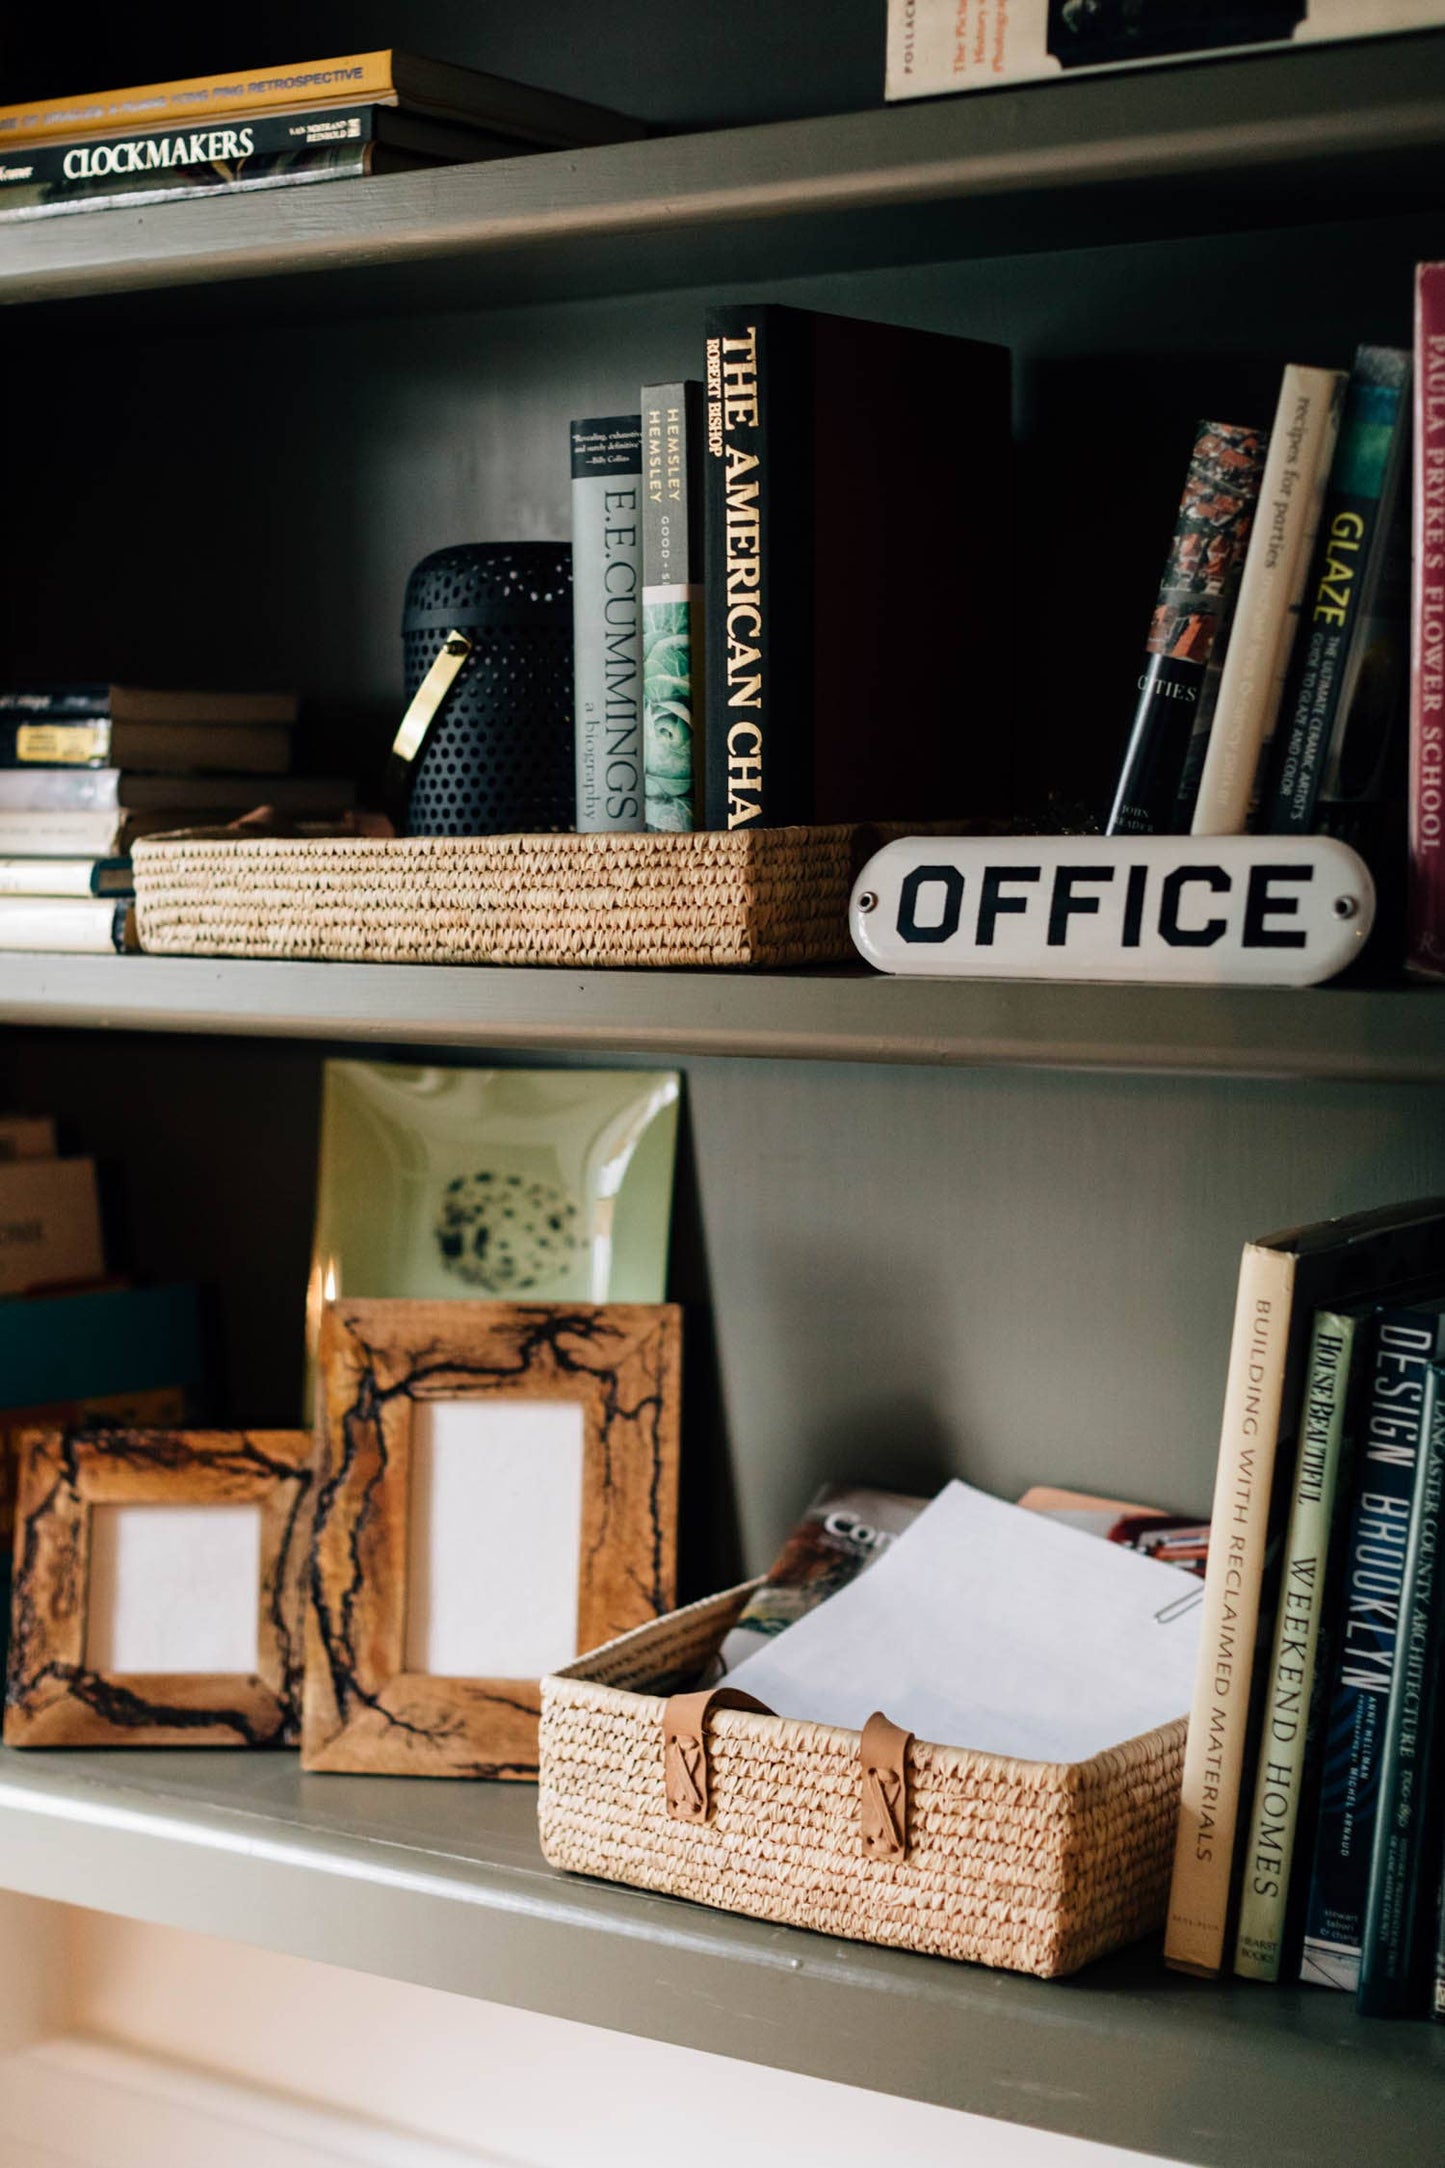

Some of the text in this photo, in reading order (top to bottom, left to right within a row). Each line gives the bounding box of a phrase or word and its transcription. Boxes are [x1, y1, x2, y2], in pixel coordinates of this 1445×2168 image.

[247, 66, 364, 94] RETROSPECTIVE
[62, 127, 255, 180] CLOCKMAKERS
[706, 338, 724, 457] ROBERT BISHOP
[1427, 335, 1445, 433] PAULA
[649, 410, 662, 503] HEMSLEY
[667, 408, 681, 501] HEMSLEY
[1264, 397, 1310, 570] recipes for parties
[661, 516, 670, 558] GOOD
[722, 326, 763, 831] THE AMERICAN CHA
[1313, 511, 1365, 627] GLAZE
[1136, 674, 1198, 703] CTIES
[1312, 659, 1334, 715] ULTIMATE
[1422, 585, 1445, 713] FLOWER
[582, 702, 601, 820] a biography
[1280, 757, 1298, 797] COLOR
[1288, 730, 1303, 756] AND
[1301, 717, 1323, 771] CERAMIC
[1421, 727, 1442, 856] SCHOOL
[895, 864, 1314, 949] OFFICE
[1298, 1333, 1343, 1506] HOUSE BEAUTIFUL
[1422, 1400, 1445, 1514] LANCASTER
[1341, 1324, 1433, 1694] DESIGN BROOKLYN
[1195, 1298, 1271, 1863] BUILDING WITH RECLAIMED MATERIALS
[1413, 1518, 1438, 1605] COUNTY
[1253, 1557, 1318, 1899] WEEKEND HOMES
[1400, 1607, 1429, 1759] ARCHITECTURE
[1360, 1696, 1378, 1779] ANNE HELLMAN
[1345, 1767, 1360, 1808] MICHEL
[1340, 1812, 1353, 1857] ARNAUD
